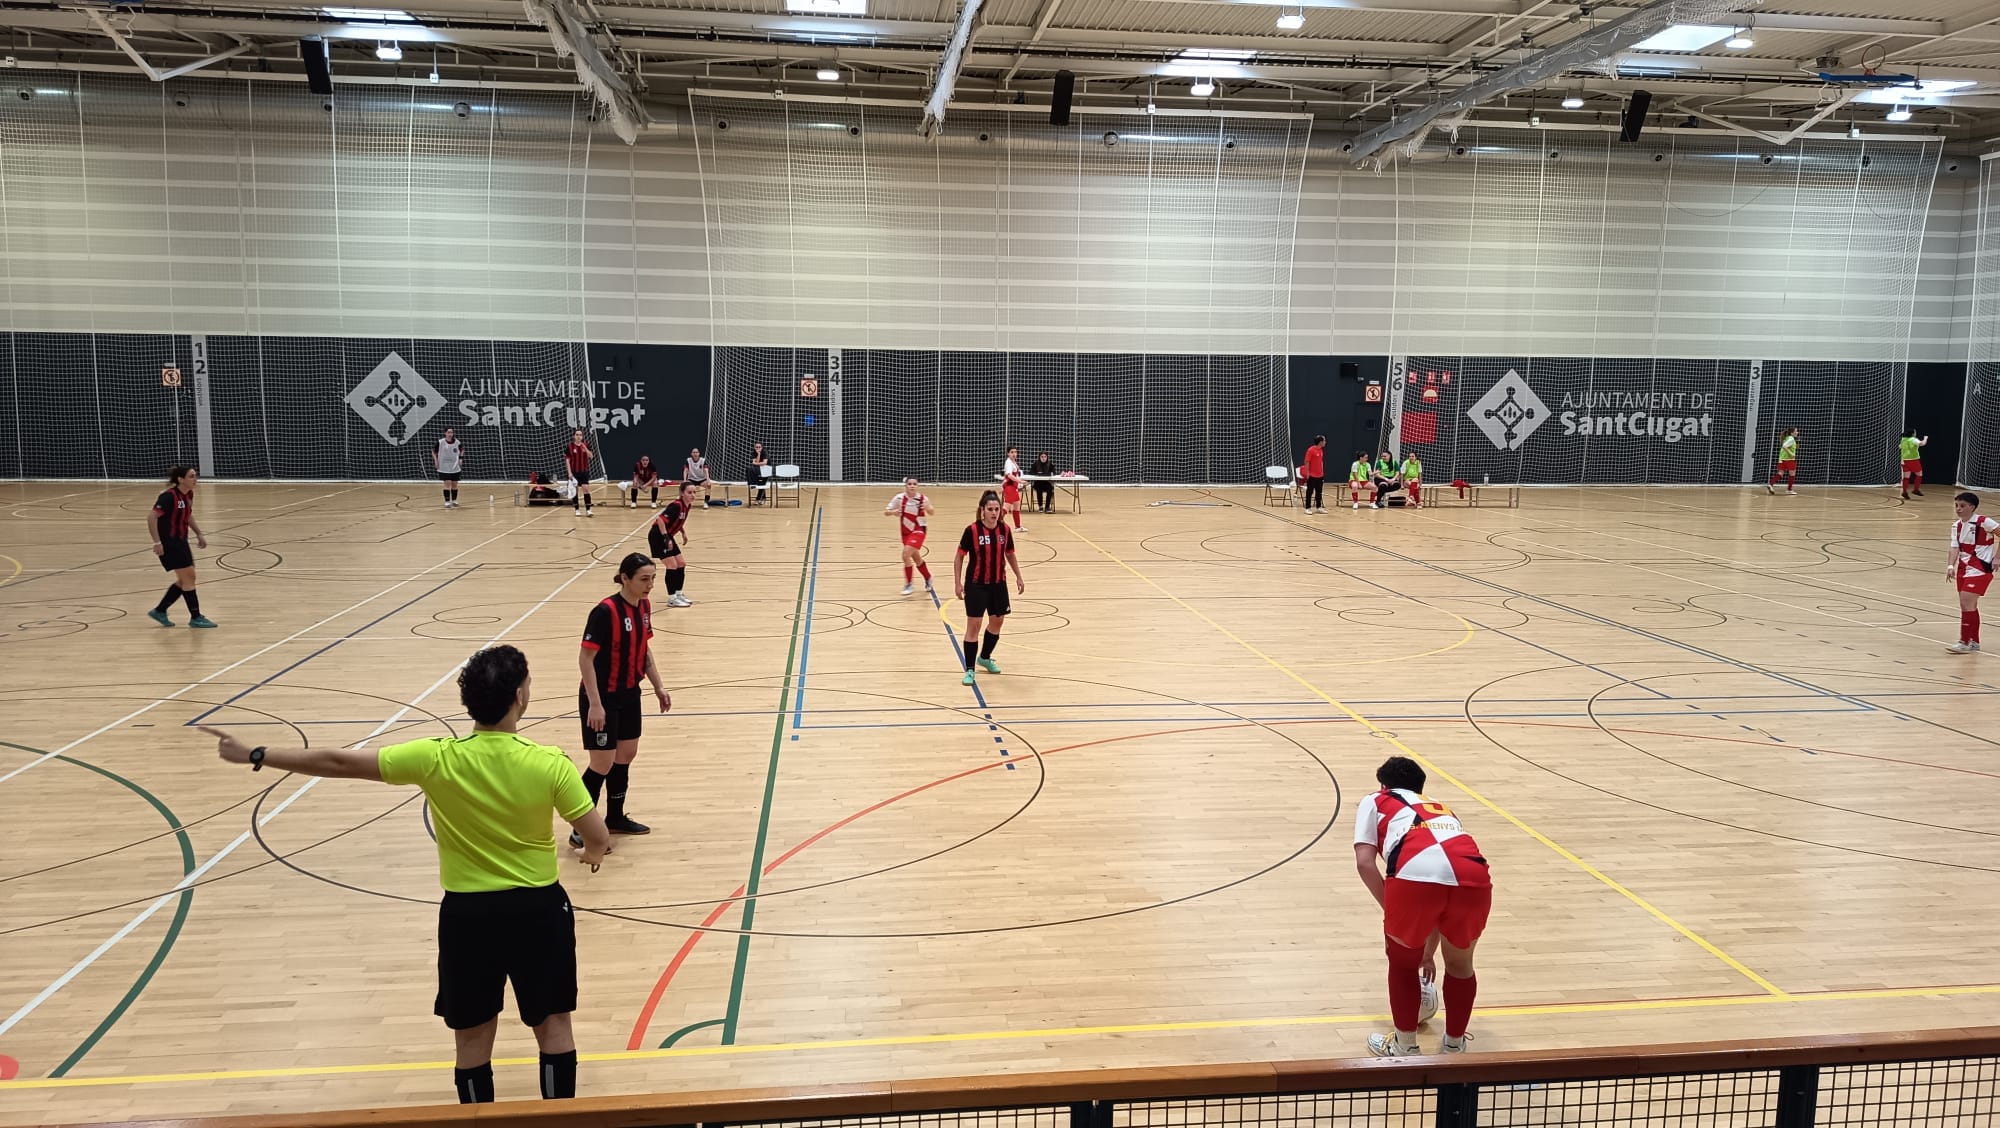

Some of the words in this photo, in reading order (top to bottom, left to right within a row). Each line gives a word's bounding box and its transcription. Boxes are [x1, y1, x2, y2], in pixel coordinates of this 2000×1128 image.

[194, 342, 203, 357] 1
[195, 360, 206, 374] 2
[830, 355, 840, 370] 3
[1393, 362, 1403, 376] 5
[830, 371, 841, 386] 4
[1751, 366, 1760, 380] 3
[458, 377, 612, 399] AJUNTAMENT
[617, 381, 646, 400] DE
[1392, 377, 1403, 391] 6
[1560, 391, 1687, 409] AJUNTAMENT
[1691, 392, 1715, 410] DE
[458, 400, 646, 434] SantCugat
[1560, 411, 1713, 443] SantCugat
[978, 535, 991, 545] 25
[624, 617, 632, 631] 8
